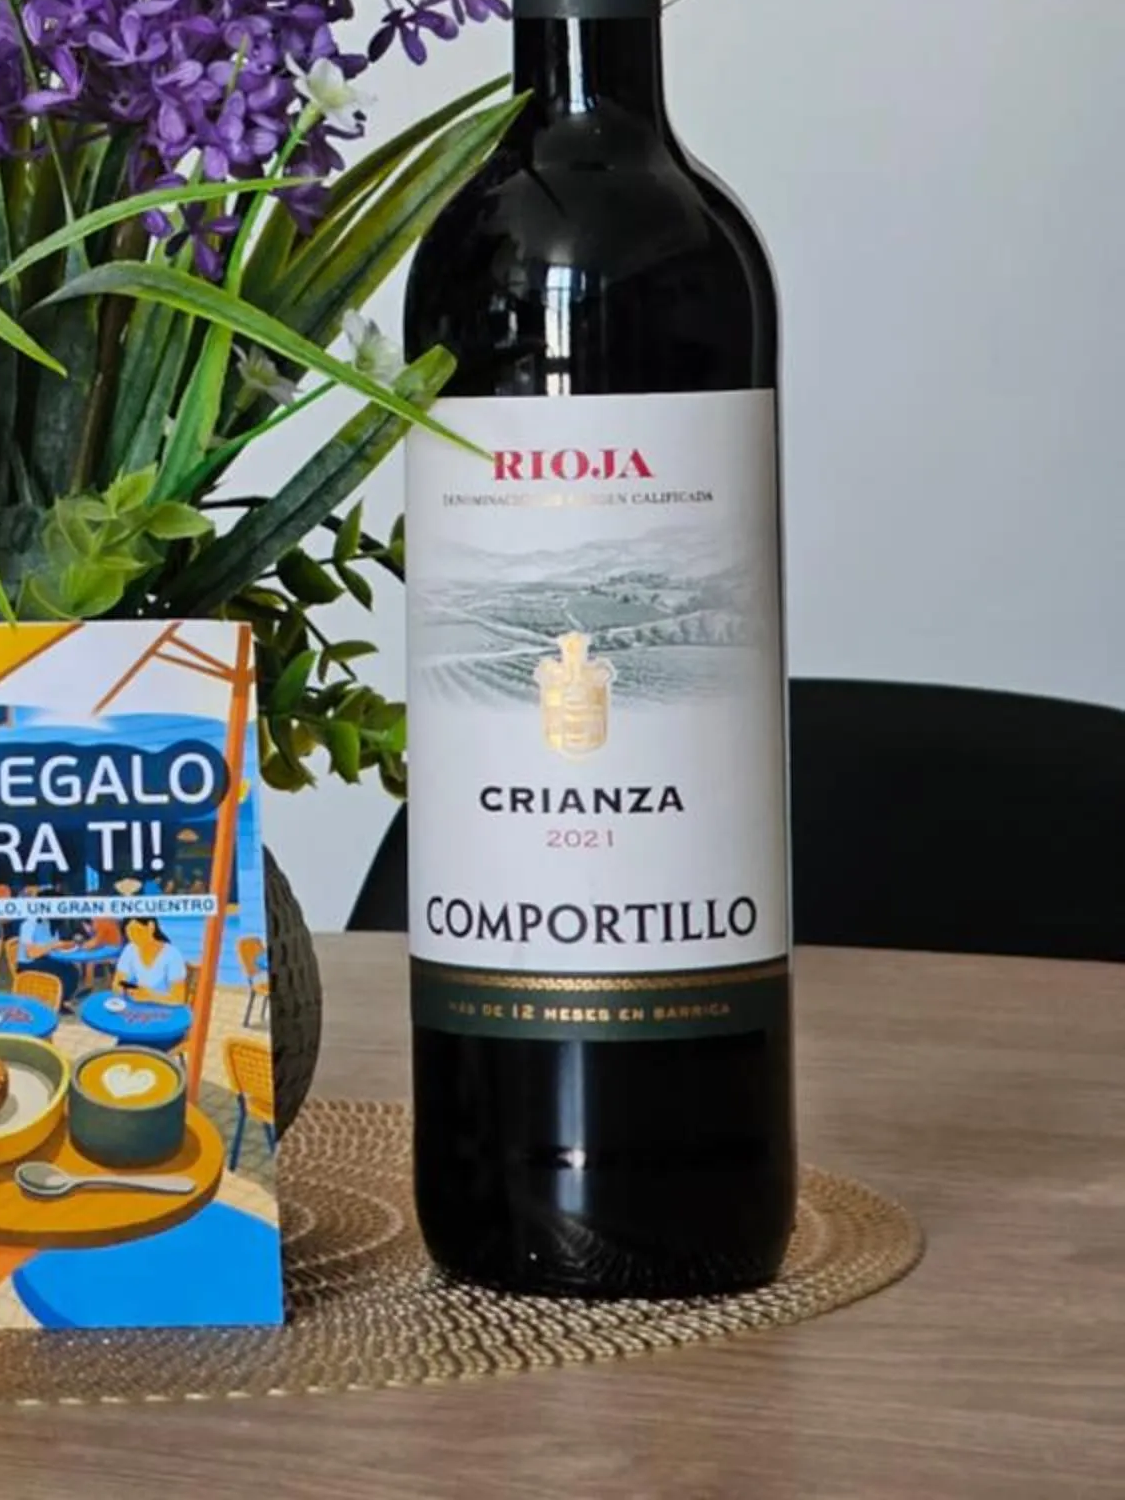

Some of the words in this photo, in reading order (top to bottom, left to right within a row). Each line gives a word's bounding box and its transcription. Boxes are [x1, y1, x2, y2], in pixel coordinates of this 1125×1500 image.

[491, 449, 655, 481] RIOJA
[479, 786, 685, 814] CRIANZA
[87, 819, 166, 872] TI!
[545, 829, 615, 848] 2021
[26, 901, 51, 914] UN
[57, 900, 104, 914] GRAN
[110, 898, 215, 913] ENCUENTRO
[426, 896, 758, 944] COMPORTILLO
[512, 1002, 535, 1020] 12
[543, 1007, 610, 1021] MESES
[618, 1006, 644, 1020] EN
